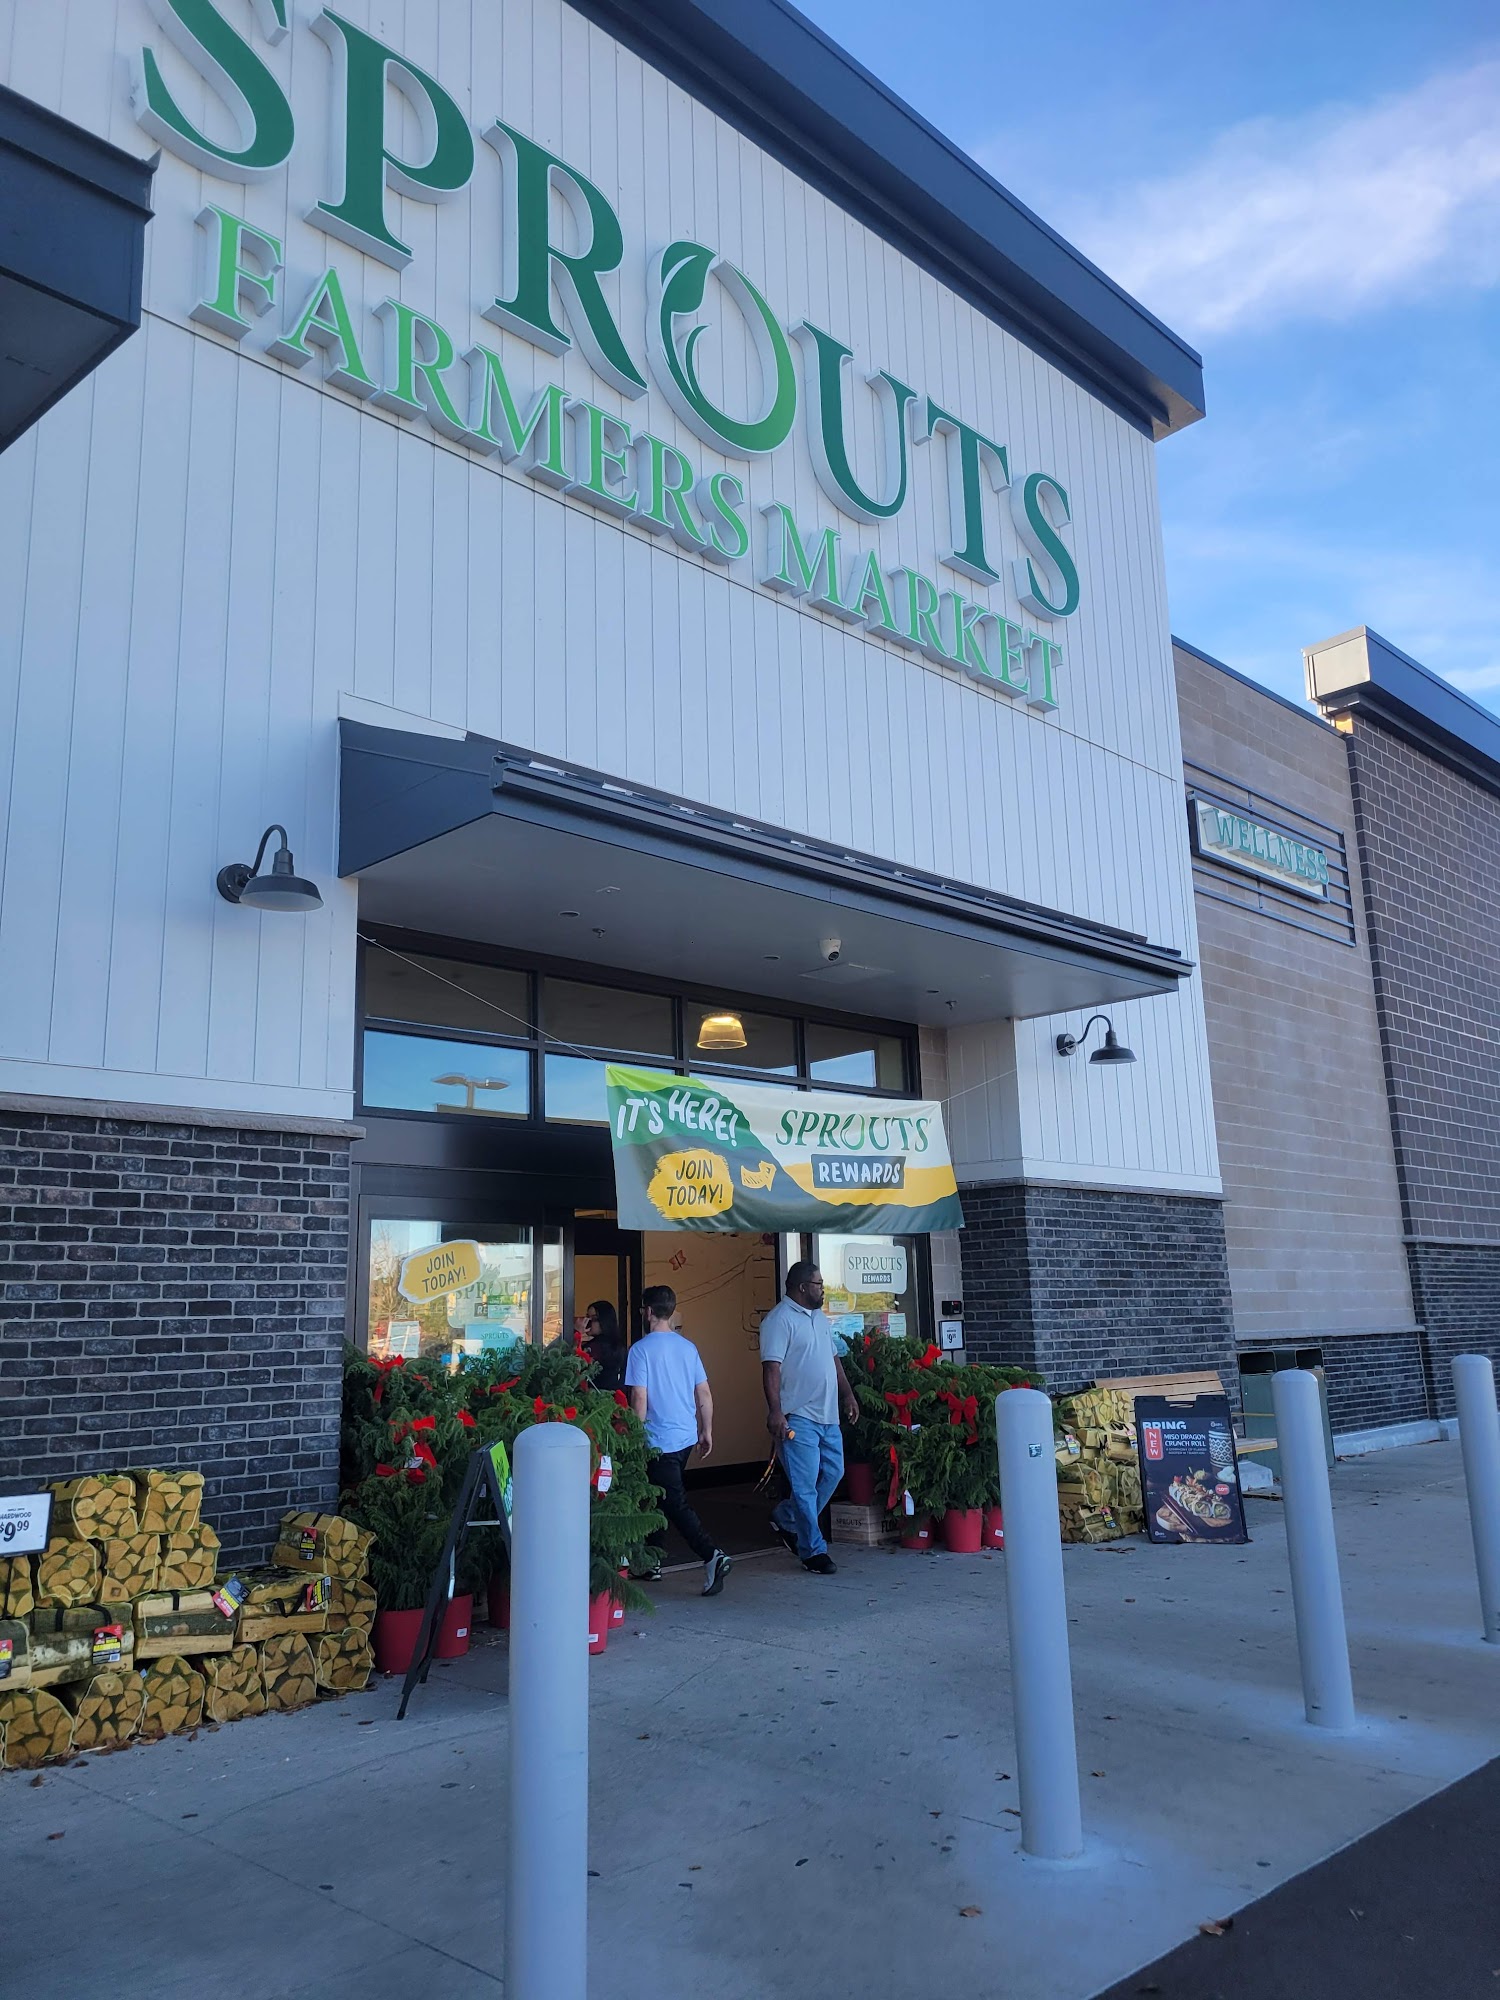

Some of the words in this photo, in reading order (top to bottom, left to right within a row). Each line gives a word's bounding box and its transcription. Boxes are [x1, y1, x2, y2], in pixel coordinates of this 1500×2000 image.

[140, 0, 1080, 618] SPROUTS
[200, 202, 750, 560] FARMERS
[770, 500, 1064, 707] MARKET
[1211, 808, 1330, 886] WELLNESS
[616, 1097, 664, 1140] IT'S
[668, 1089, 739, 1147] HERE!
[775, 1109, 929, 1153] SPROUTS
[675, 1159, 713, 1181] JOIN
[818, 1162, 901, 1184] REWARDS
[666, 1183, 723, 1206] TODAY!
[426, 1251, 456, 1274] JOIN
[848, 1256, 904, 1271] SPROUTS
[421, 1265, 467, 1294] TODAY!
[863, 1274, 891, 1283] REWARDS
[1148, 1431, 1159, 1457] NEW
[1163, 1433, 1180, 1441] MISO
[1180, 1433, 1206, 1441] DRAGON
